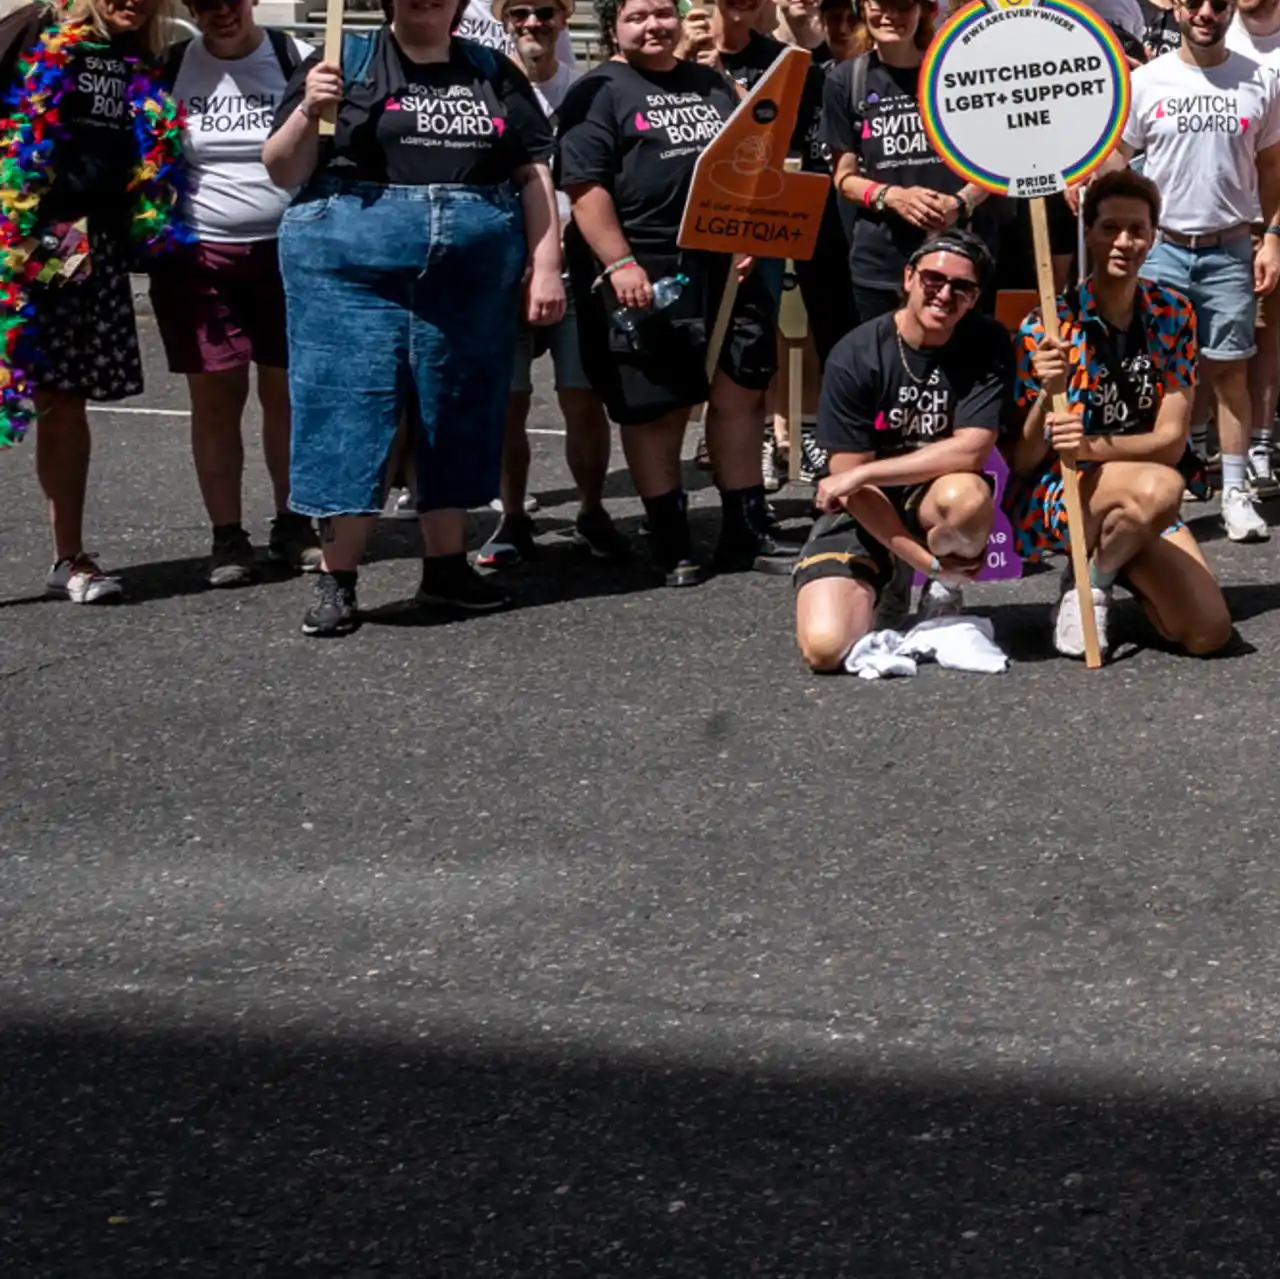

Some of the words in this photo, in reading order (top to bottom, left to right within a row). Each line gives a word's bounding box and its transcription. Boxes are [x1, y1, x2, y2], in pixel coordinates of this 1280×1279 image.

[944, 56, 1101, 88] SWITCHBOARD
[189, 94, 275, 116] SWITCH
[400, 96, 489, 117] SWITCH
[945, 91, 1008, 113] LGBT+
[1012, 79, 1106, 104] SUPPORT
[1167, 96, 1237, 116] SWITCH
[417, 113, 494, 135] BOARD
[647, 104, 722, 129] SWITCH
[1007, 110, 1051, 130] LINE
[1177, 116, 1239, 134] BOARD
[1016, 174, 1056, 189] PRIDE
